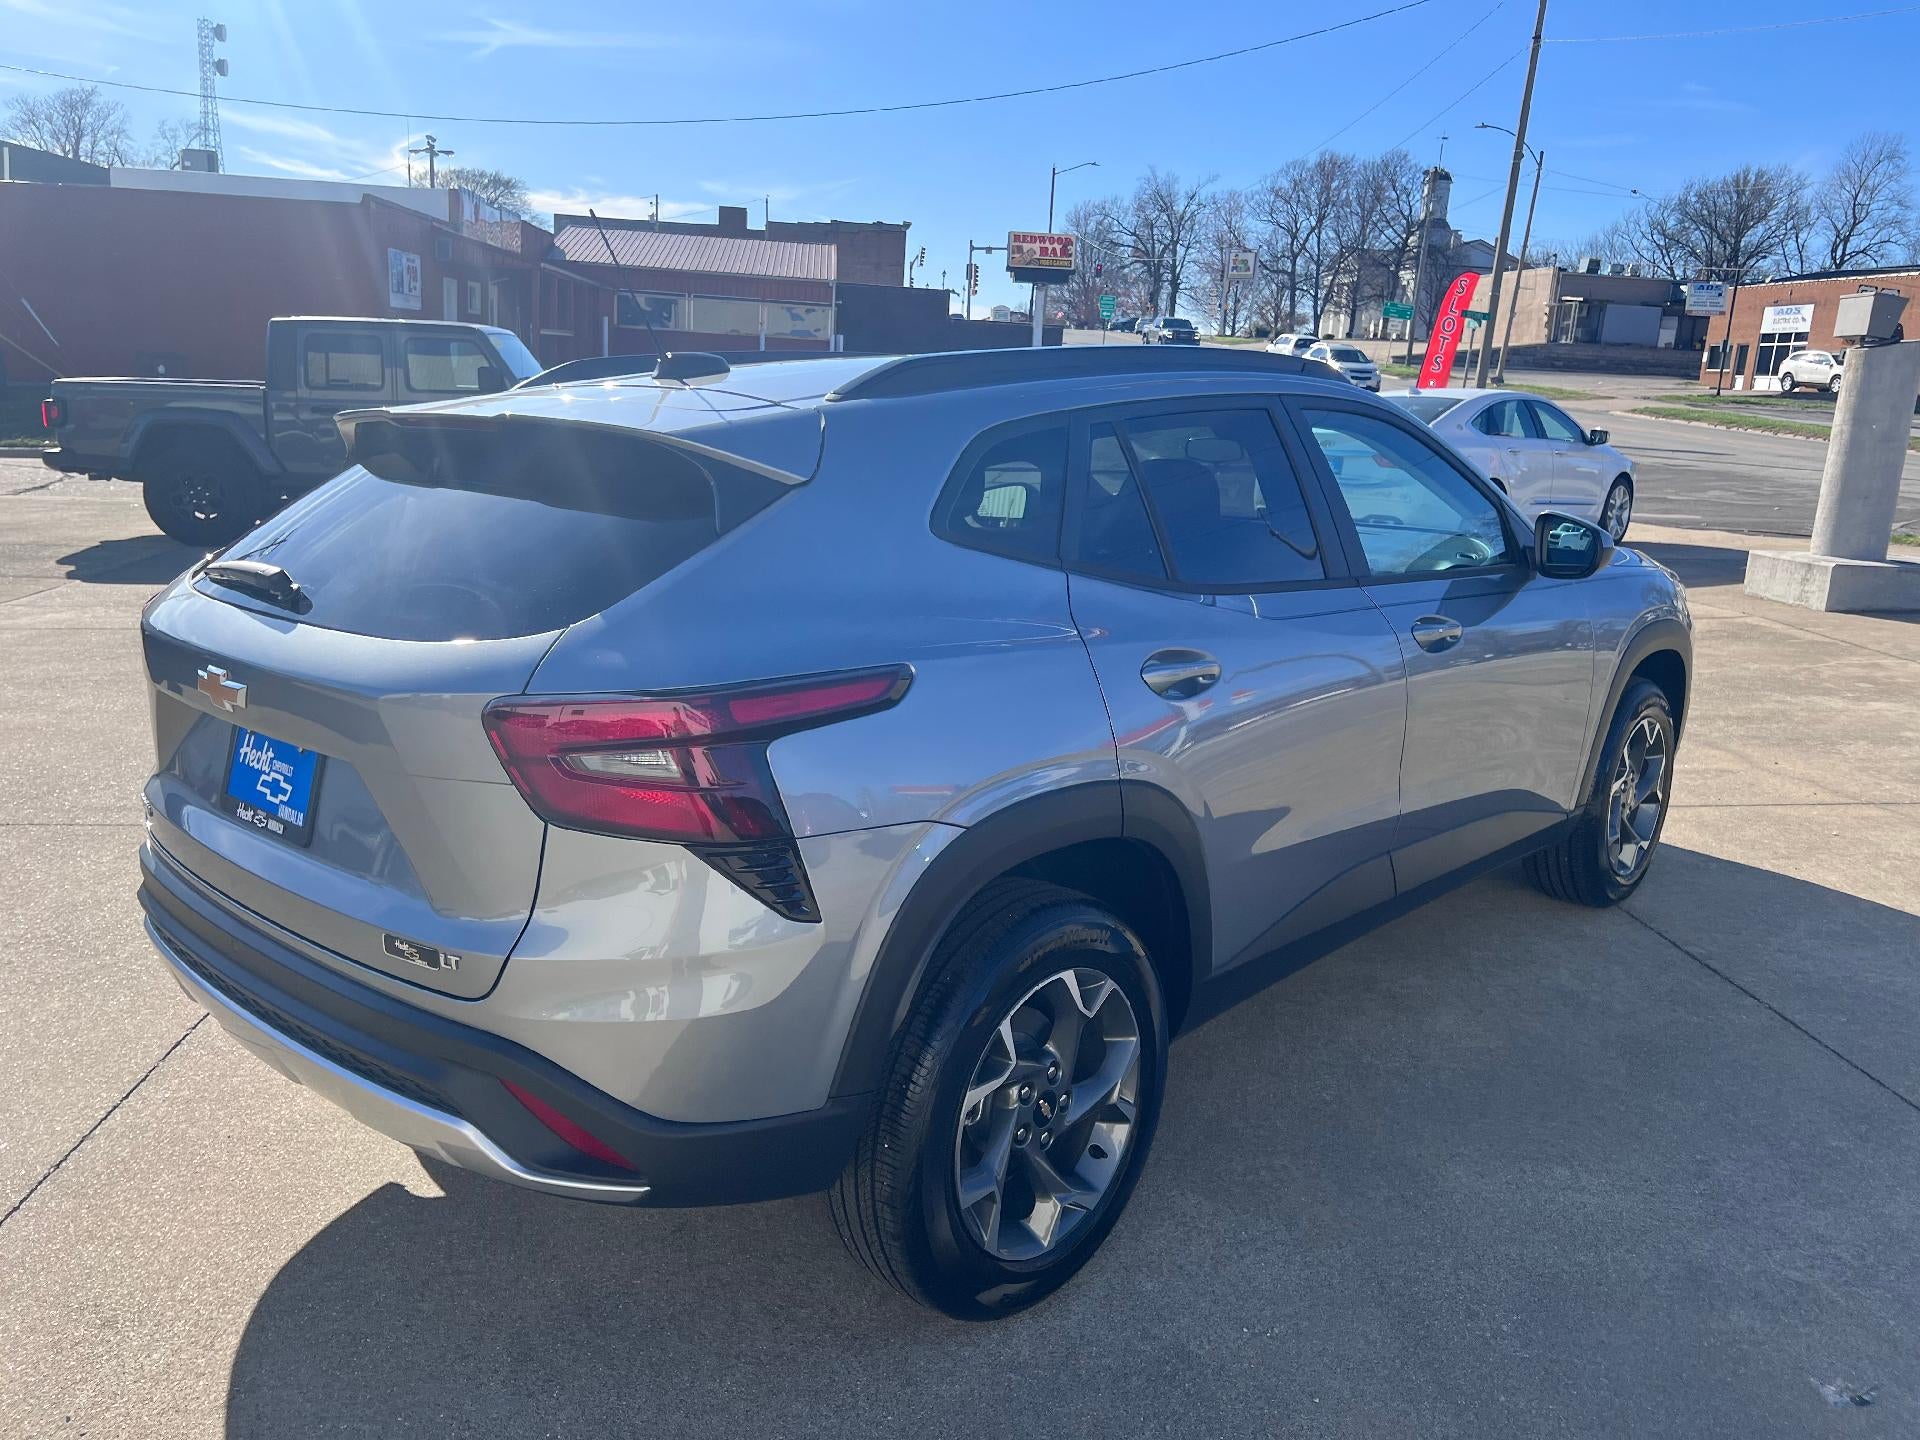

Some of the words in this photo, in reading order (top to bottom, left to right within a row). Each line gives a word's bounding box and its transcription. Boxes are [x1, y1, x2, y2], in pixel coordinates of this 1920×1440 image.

[1013, 234, 1074, 246] REDWOOD
[1039, 247, 1073, 258] BAR
[1776, 307, 1801, 315] ADS
[1431, 279, 1469, 373] SLOTS
[240, 733, 275, 773] Hecht
[237, 802, 254, 822] Hecht
[440, 953, 460, 971] LT
